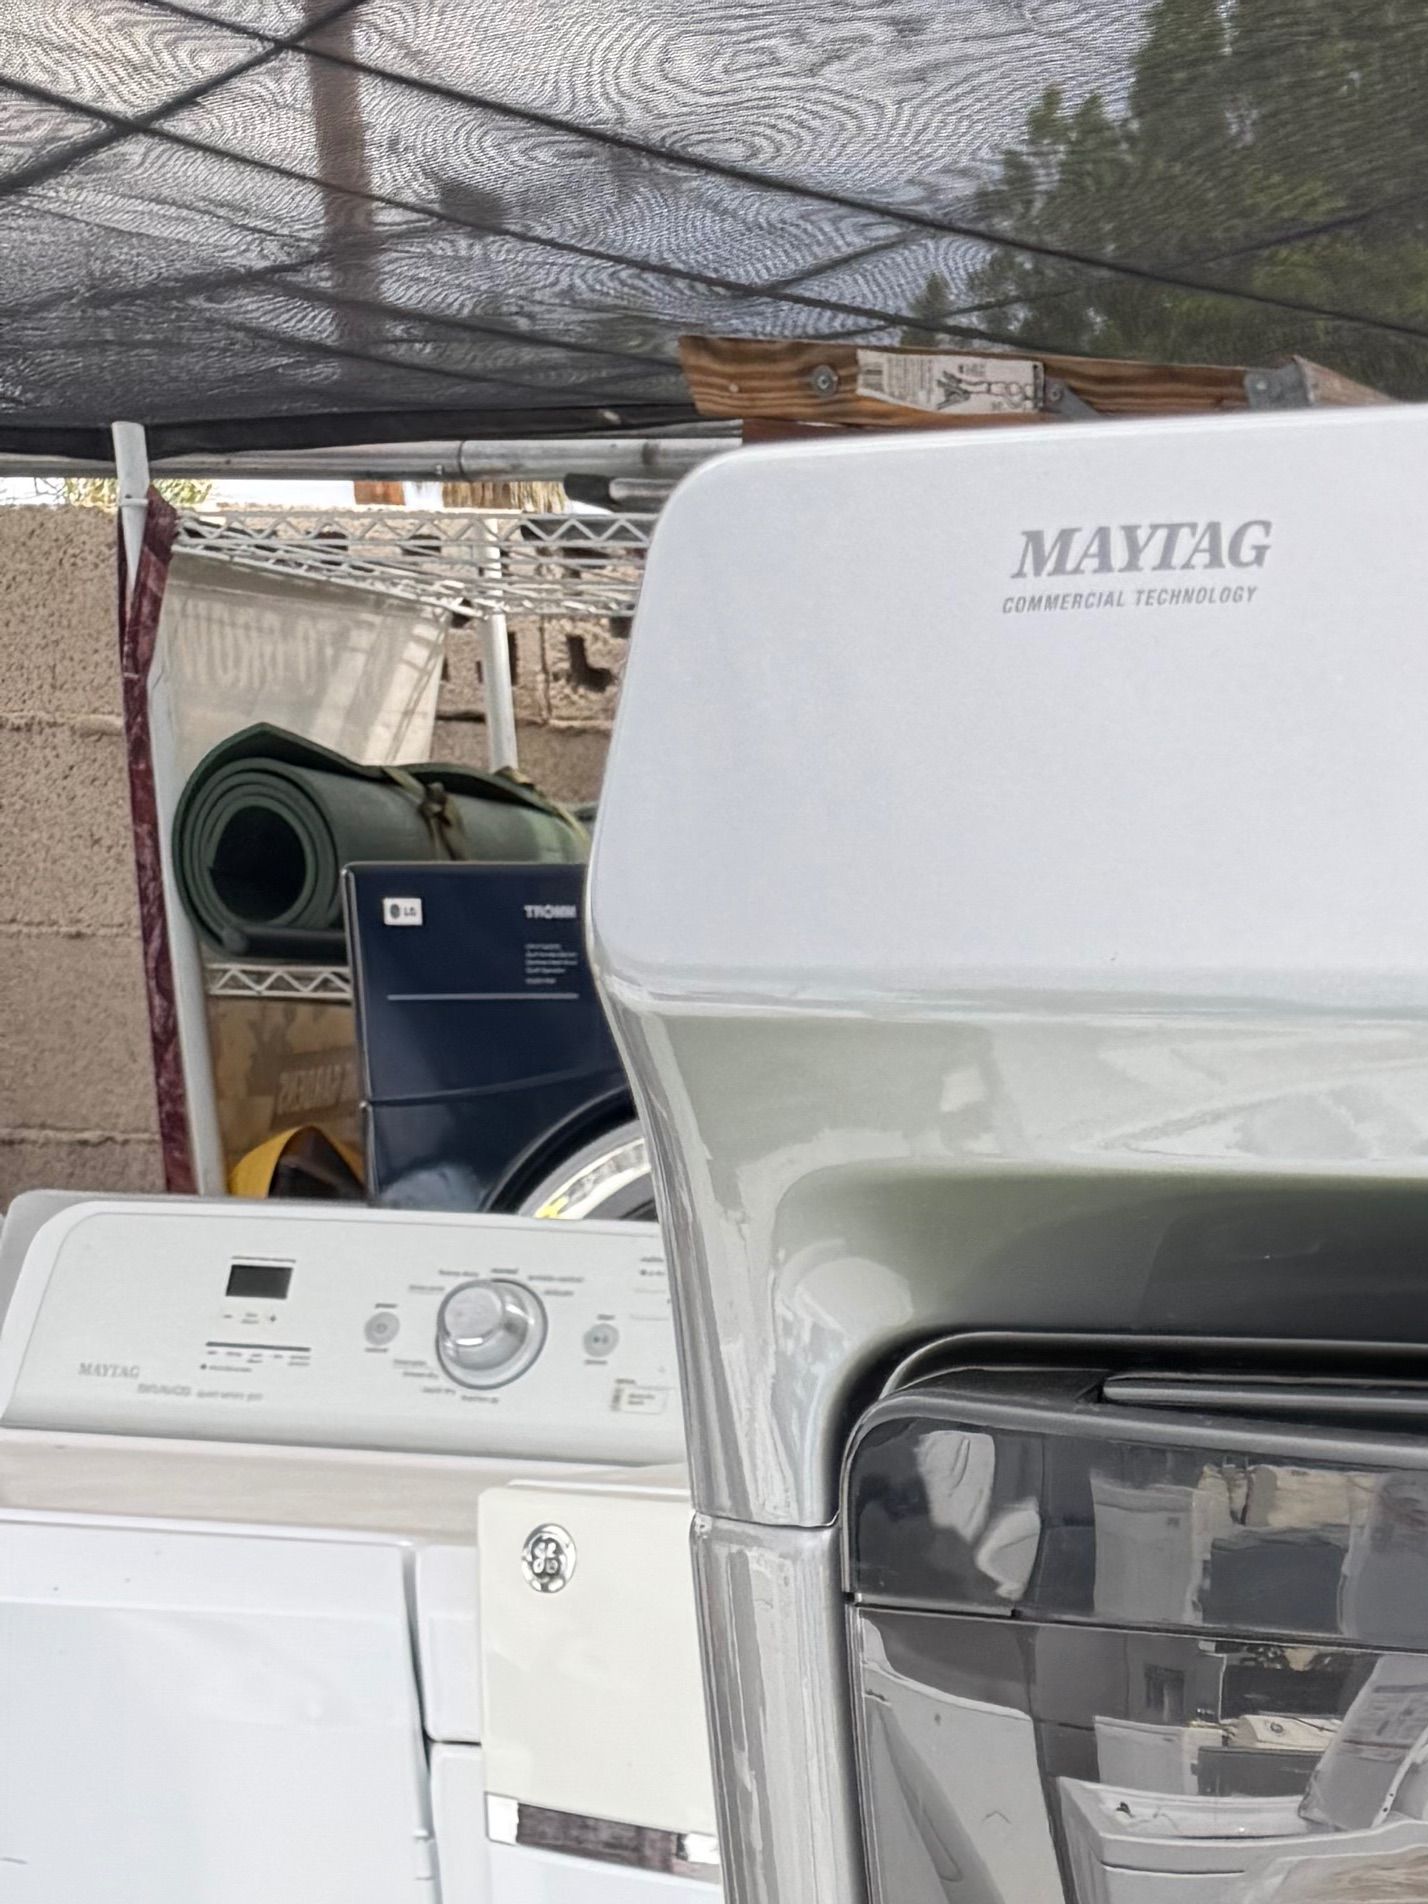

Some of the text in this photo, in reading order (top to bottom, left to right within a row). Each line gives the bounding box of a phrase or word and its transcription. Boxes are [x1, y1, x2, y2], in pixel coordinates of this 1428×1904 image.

[1010, 519, 1273, 579] MAYTAG
[1002, 586, 1258, 614] COMMERCIAL TECHNOLOGY
[78, 1362, 140, 1380] MAYTAG
